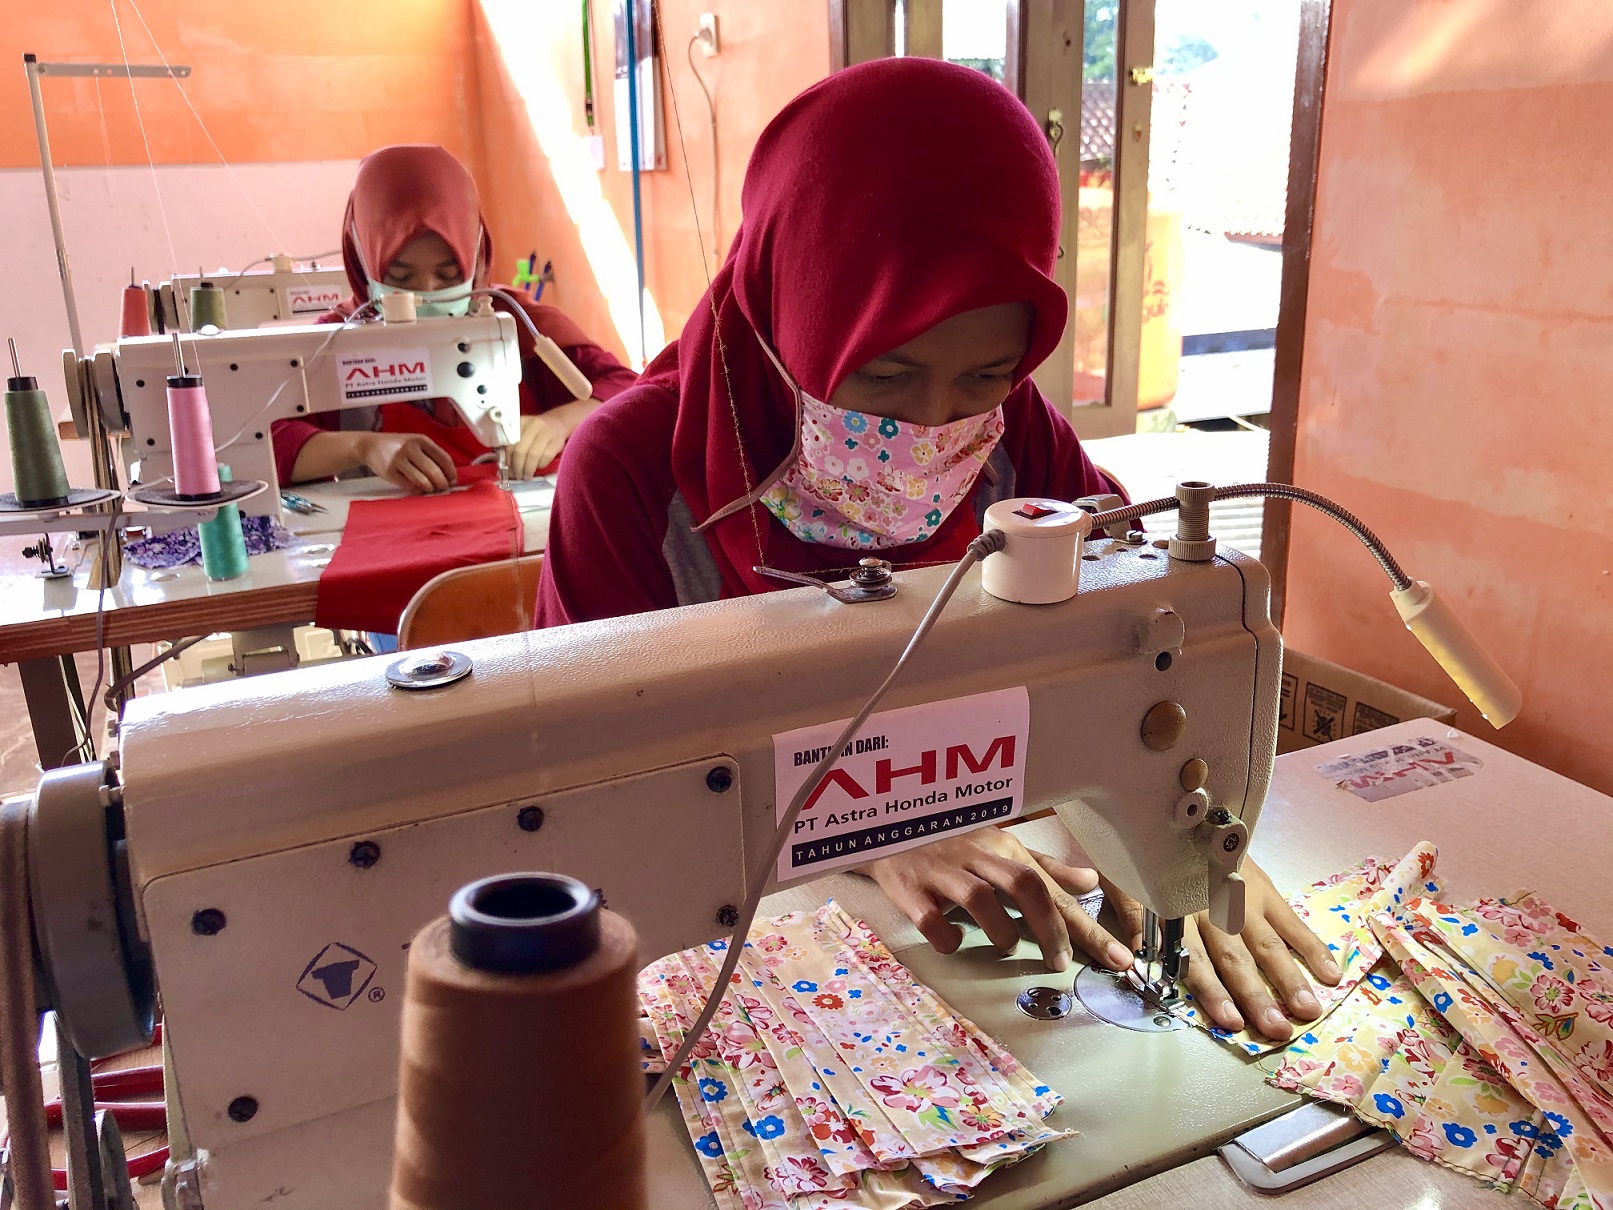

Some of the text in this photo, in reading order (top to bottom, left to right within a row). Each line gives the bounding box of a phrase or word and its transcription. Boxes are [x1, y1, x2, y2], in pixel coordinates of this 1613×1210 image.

[346, 362, 425, 380] AHM
[794, 735, 889, 766] BANTN DARI:
[802, 735, 1016, 810] AHM
[795, 778, 1013, 834] PT Astra Honda Motor
[796, 805, 1008, 860] TAHUN ANGGARAN 2019
